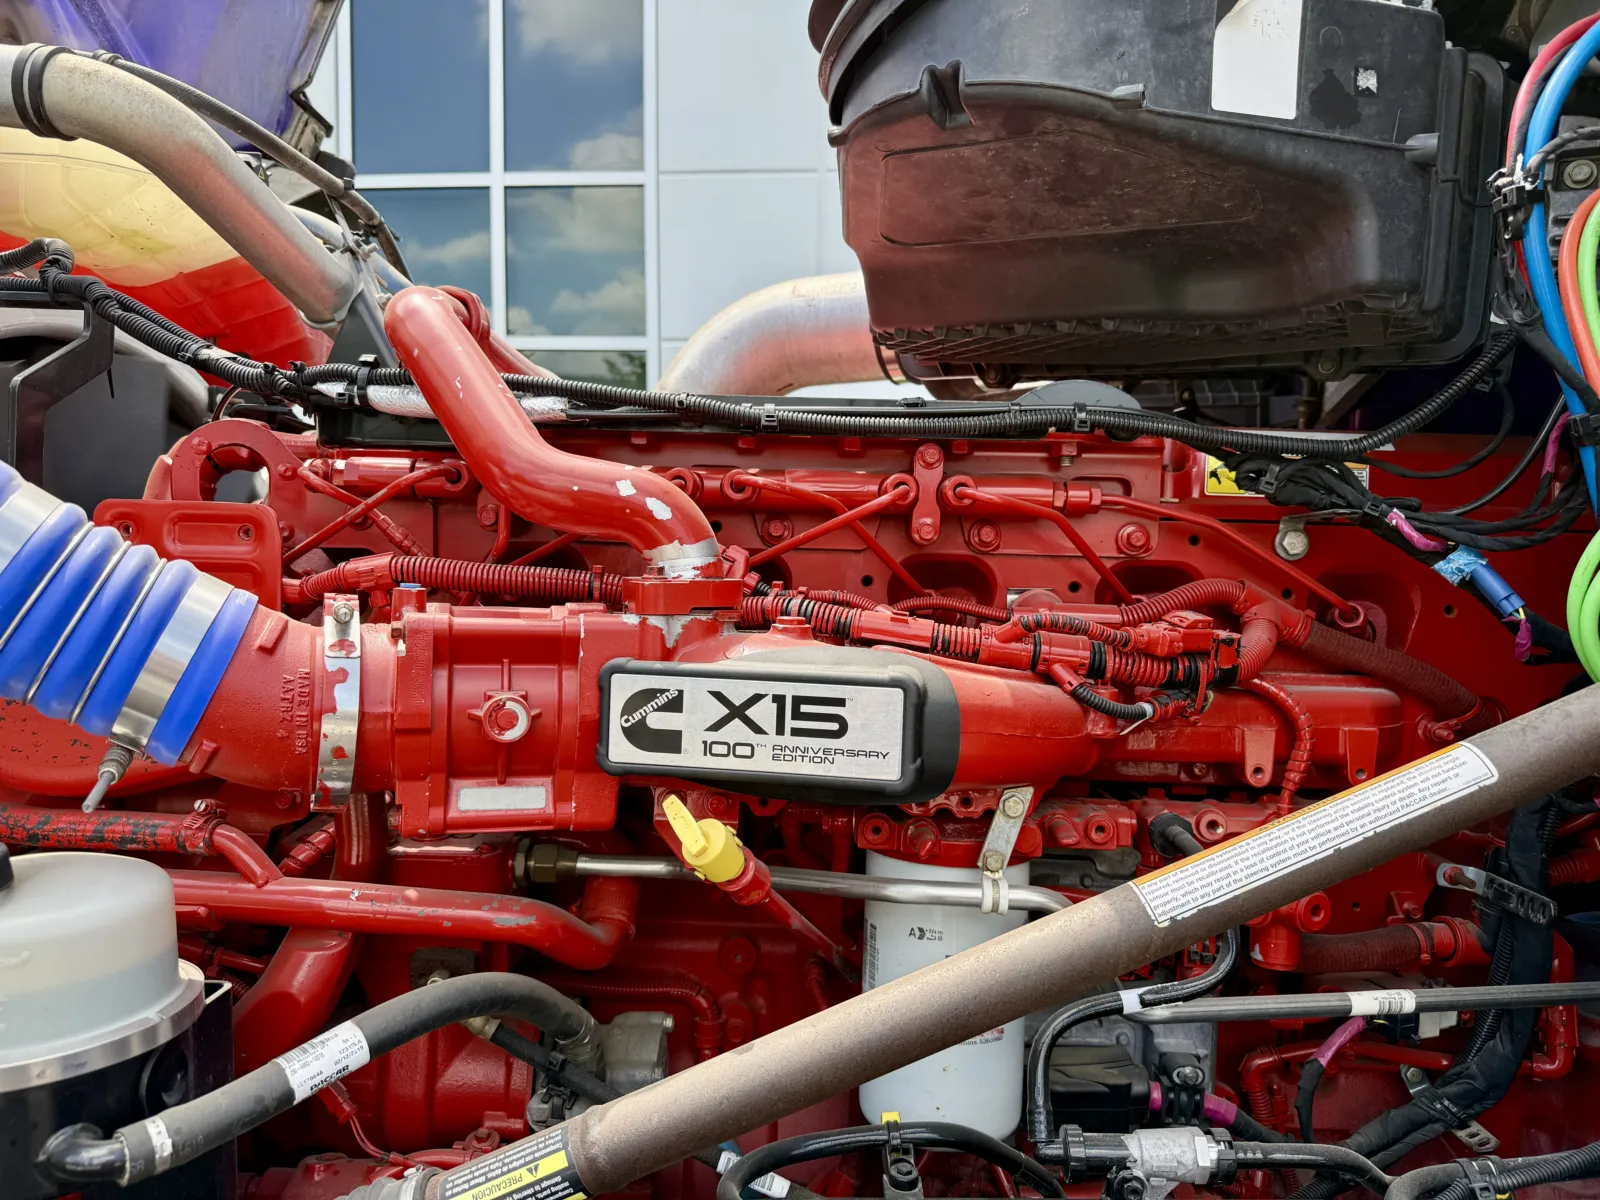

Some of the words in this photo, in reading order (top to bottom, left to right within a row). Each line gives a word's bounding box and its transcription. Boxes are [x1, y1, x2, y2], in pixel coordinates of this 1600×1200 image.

[296, 668, 310, 706] MADE
[295, 711, 308, 726] IN
[620, 688, 678, 728] Cummins
[703, 690, 849, 739] X15
[295, 730, 308, 755] USA
[772, 744, 890, 760] ANNIVERSARY
[772, 753, 835, 765] EDITION
[1149, 891, 1169, 903] sensor
[1169, 883, 1186, 894] must
[1195, 862, 1233, 882] recalibrated.
[1239, 855, 1250, 863] the
[1250, 837, 1289, 858] recalibration
[1295, 830, 1306, 838] not
[1306, 816, 1339, 834] performed
[1338, 811, 1350, 819] the
[1349, 800, 1374, 815] stability
[1374, 790, 1396, 804] control
[1396, 780, 1419, 795] system
[1419, 775, 1430, 784] will
[1430, 770, 1441, 779] not
[1441, 759, 1467, 774] function
[1152, 894, 1180, 911] properly,
[1180, 886, 1198, 898] which
[1199, 881, 1213, 890] may
[1212, 871, 1231, 883] result
[1243, 860, 1257, 869] loss
[1265, 847, 1287, 860] control
[1295, 838, 1309, 848] your
[1309, 827, 1331, 840] vehicle
[1332, 822, 1344, 830] and
[1344, 810, 1372, 826] personal
[1371, 802, 1389, 814] injury
[1397, 789, 1417, 802] death.
[1417, 784, 1430, 794] Any
[1430, 774, 1453, 789] repairs
[1156, 898, 1191, 919] adjustment
[1199, 891, 1211, 900] any
[1210, 884, 1225, 895] part
[1232, 876, 1242, 884] the
[1243, 864, 1269, 880] steering
[1268, 854, 1292, 869] system
[1291, 846, 1308, 858] must
[1317, 828, 1350, 848] performed
[1367, 806, 1400, 825] authorized
[1400, 794, 1428, 810] PACCAR
[1428, 784, 1450, 798] dealer.
[908, 927, 916, 937] A
[309, 1064, 350, 1091] PACCAR
[470, 1172, 524, 1200] PRECAUCION
[511, 1186, 535, 1200] steering
[534, 1188, 551, 1199] parts.
[540, 1174, 562, 1188] damage
[550, 1180, 570, 1192] mating
